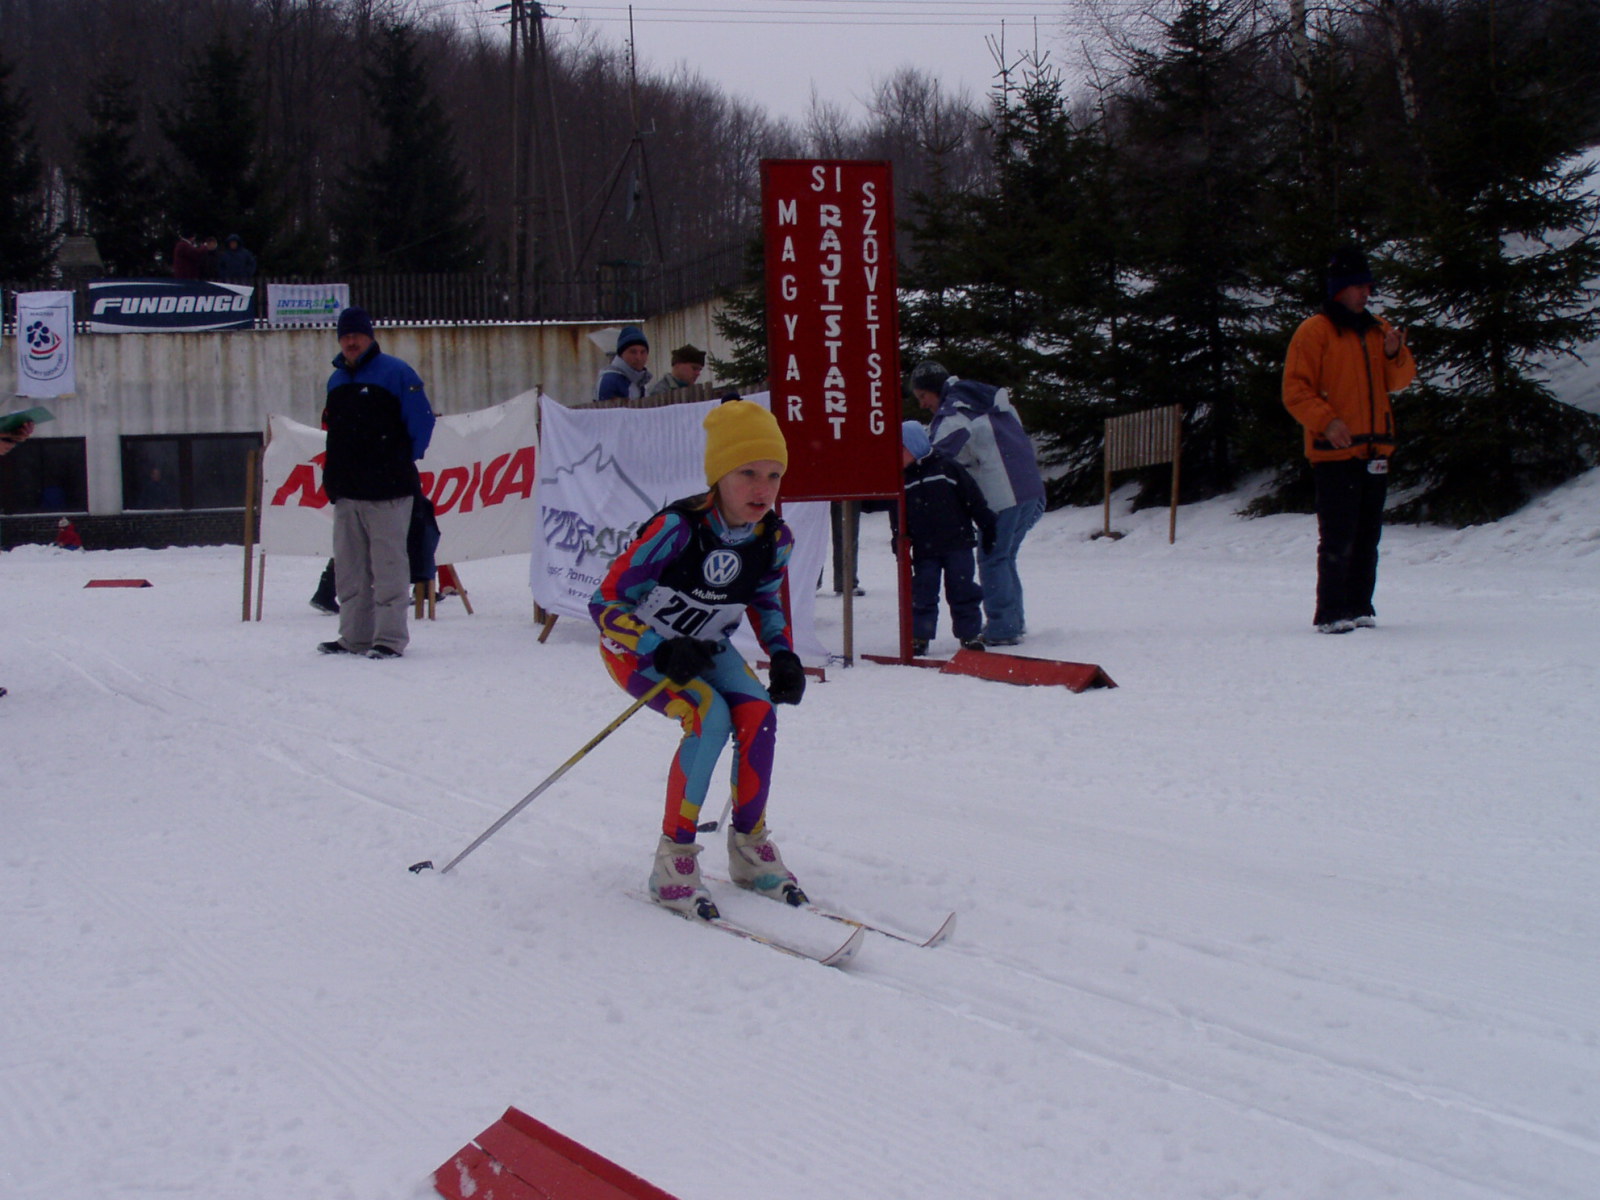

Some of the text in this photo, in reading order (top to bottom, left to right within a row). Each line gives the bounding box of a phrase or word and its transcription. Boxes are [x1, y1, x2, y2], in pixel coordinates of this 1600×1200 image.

[93, 295, 251, 315] FUNDANGO
[778, 199, 803, 422] MAGYAR
[270, 446, 536, 517] NDICA
